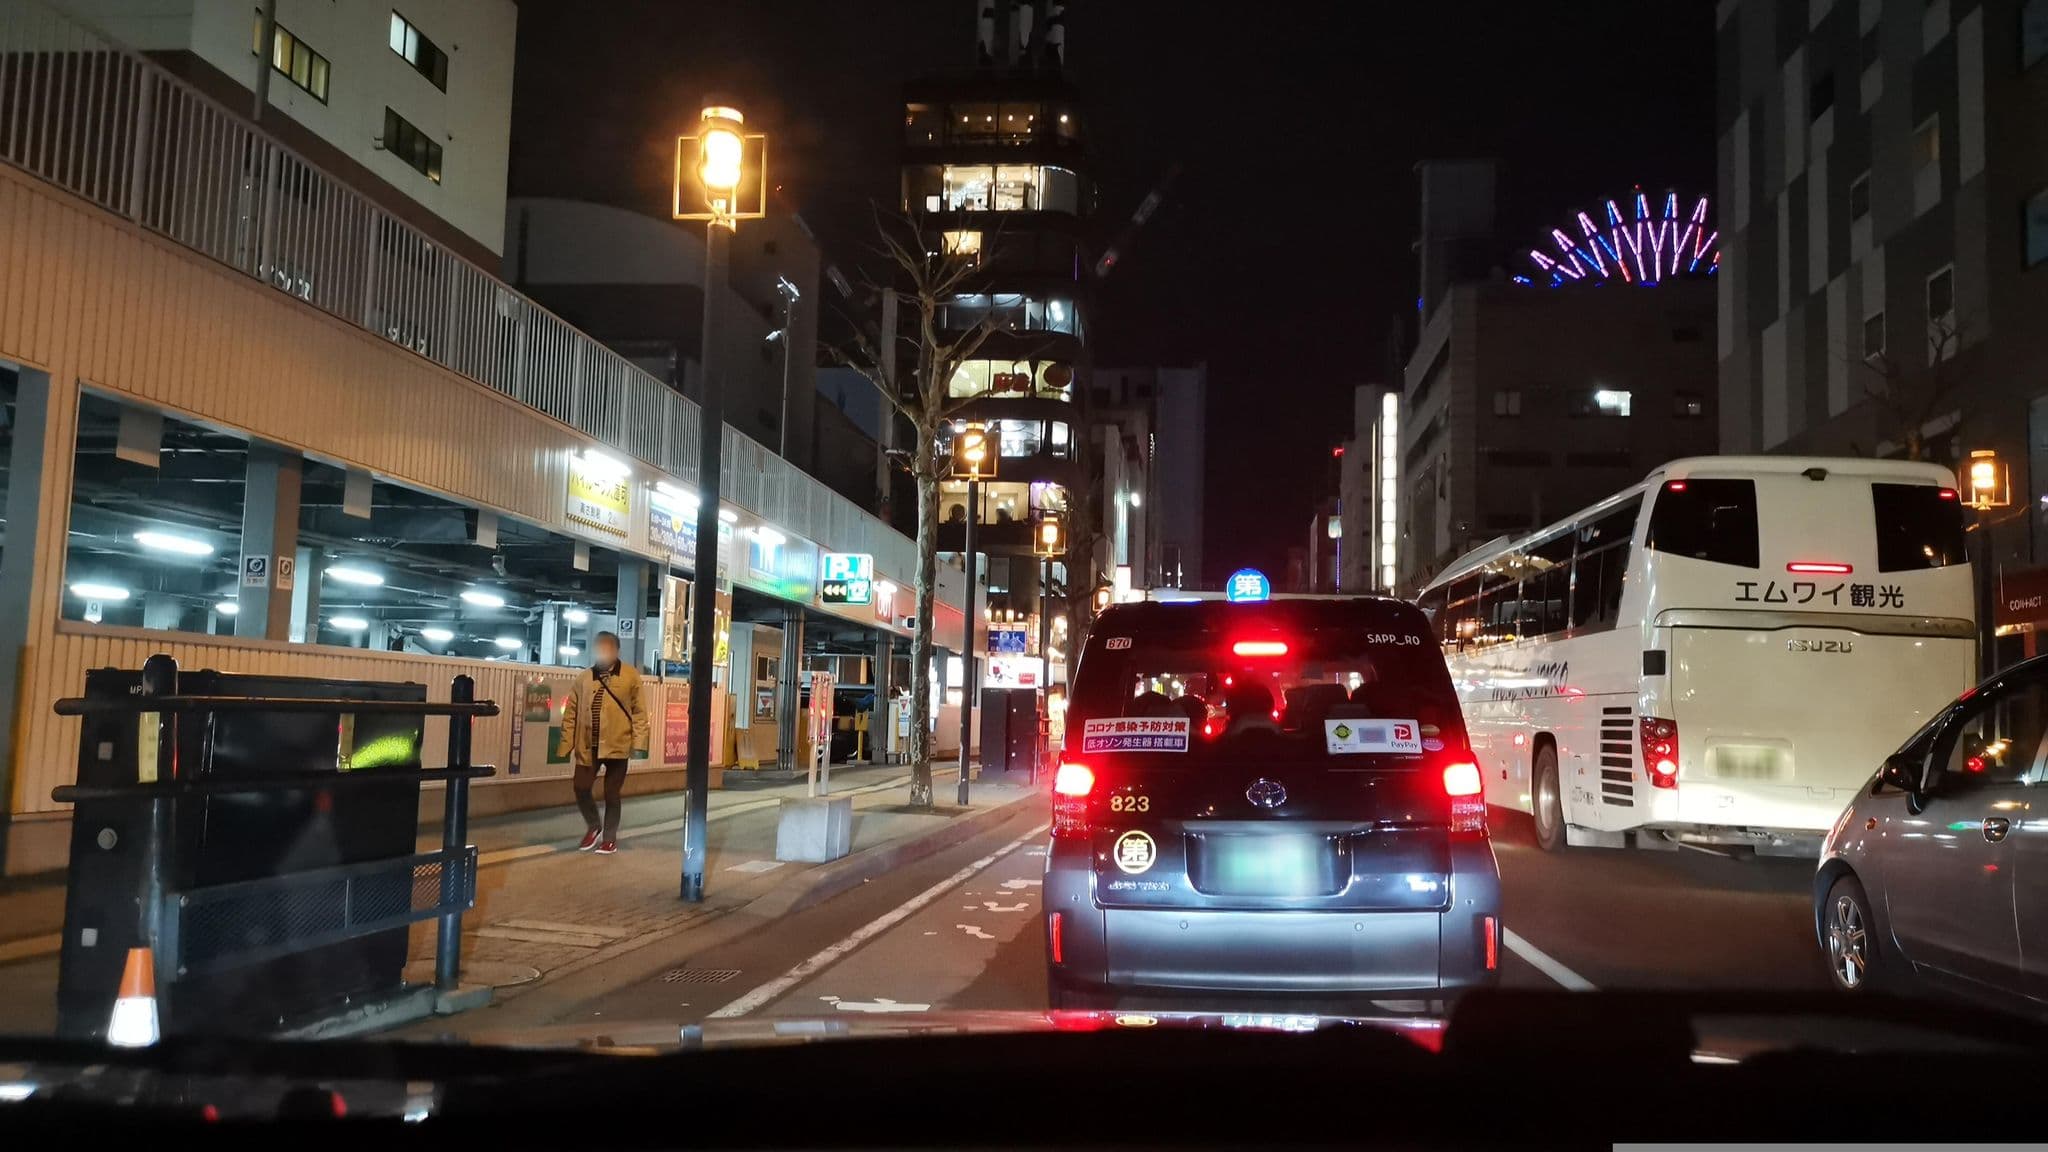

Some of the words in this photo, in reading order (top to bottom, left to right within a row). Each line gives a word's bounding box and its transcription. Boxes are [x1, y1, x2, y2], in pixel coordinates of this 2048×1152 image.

[1234, 574, 1262, 597] 第
[1735, 581, 1904, 609] エムワイ観光
[1787, 639, 1853, 653] ISUZU
[1087, 721, 1186, 733] コロナ感染予防対策
[1391, 741, 1418, 749] PayPay
[1110, 795, 1150, 812] 823
[1120, 838, 1149, 864] 第
